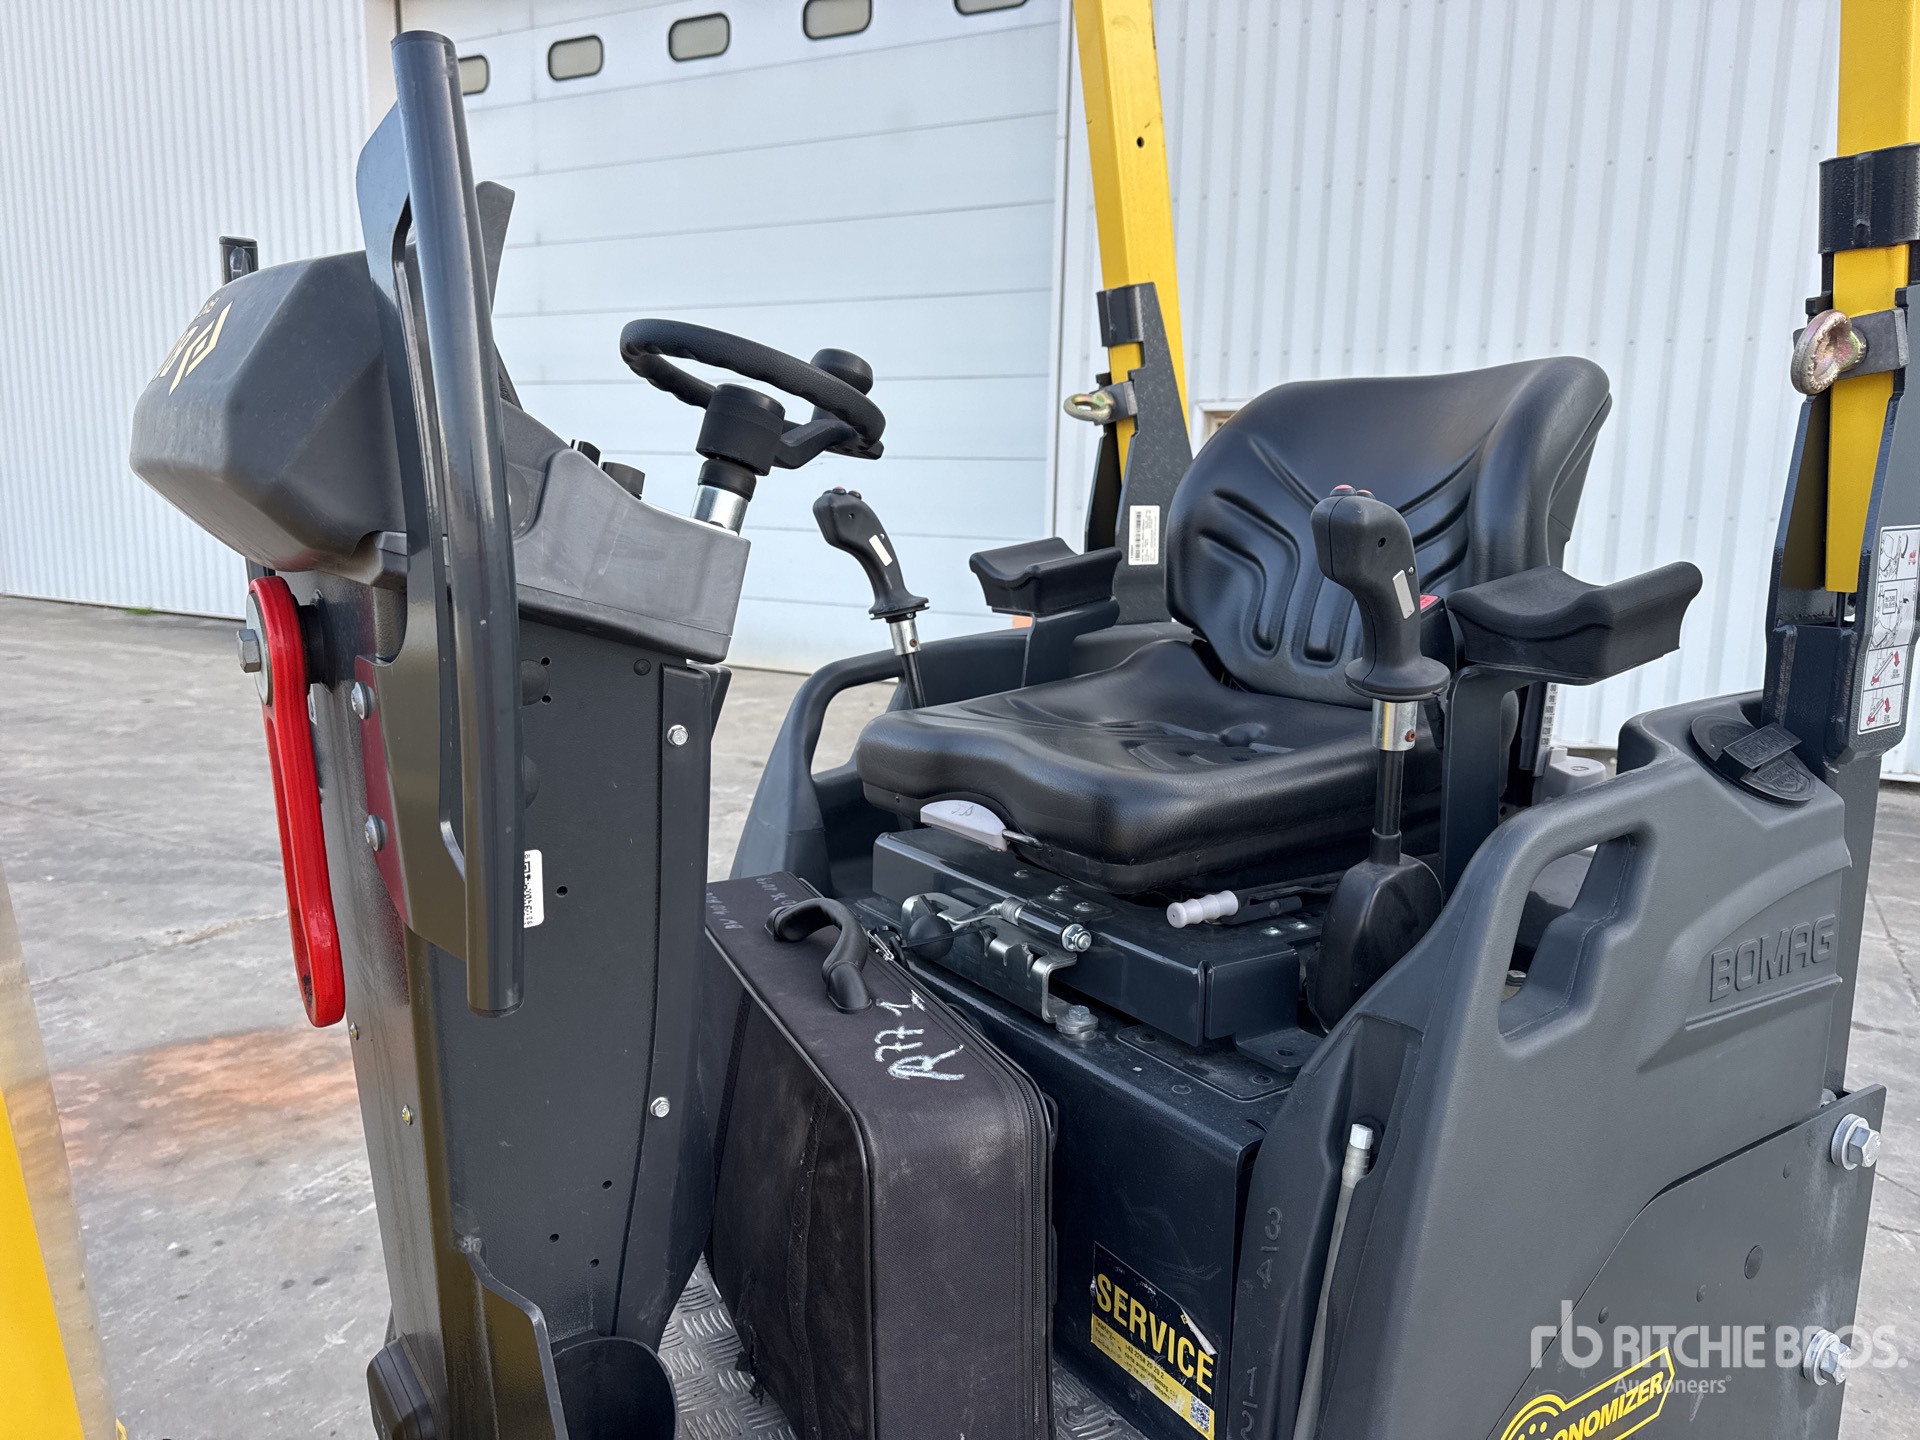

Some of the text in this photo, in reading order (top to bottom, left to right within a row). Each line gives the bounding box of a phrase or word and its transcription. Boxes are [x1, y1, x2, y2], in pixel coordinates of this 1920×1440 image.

[1708, 913, 1836, 1003] BOMAG
[1096, 1272, 1214, 1395] SERVICE
[1546, 1371, 1664, 1440] NOMIZER
